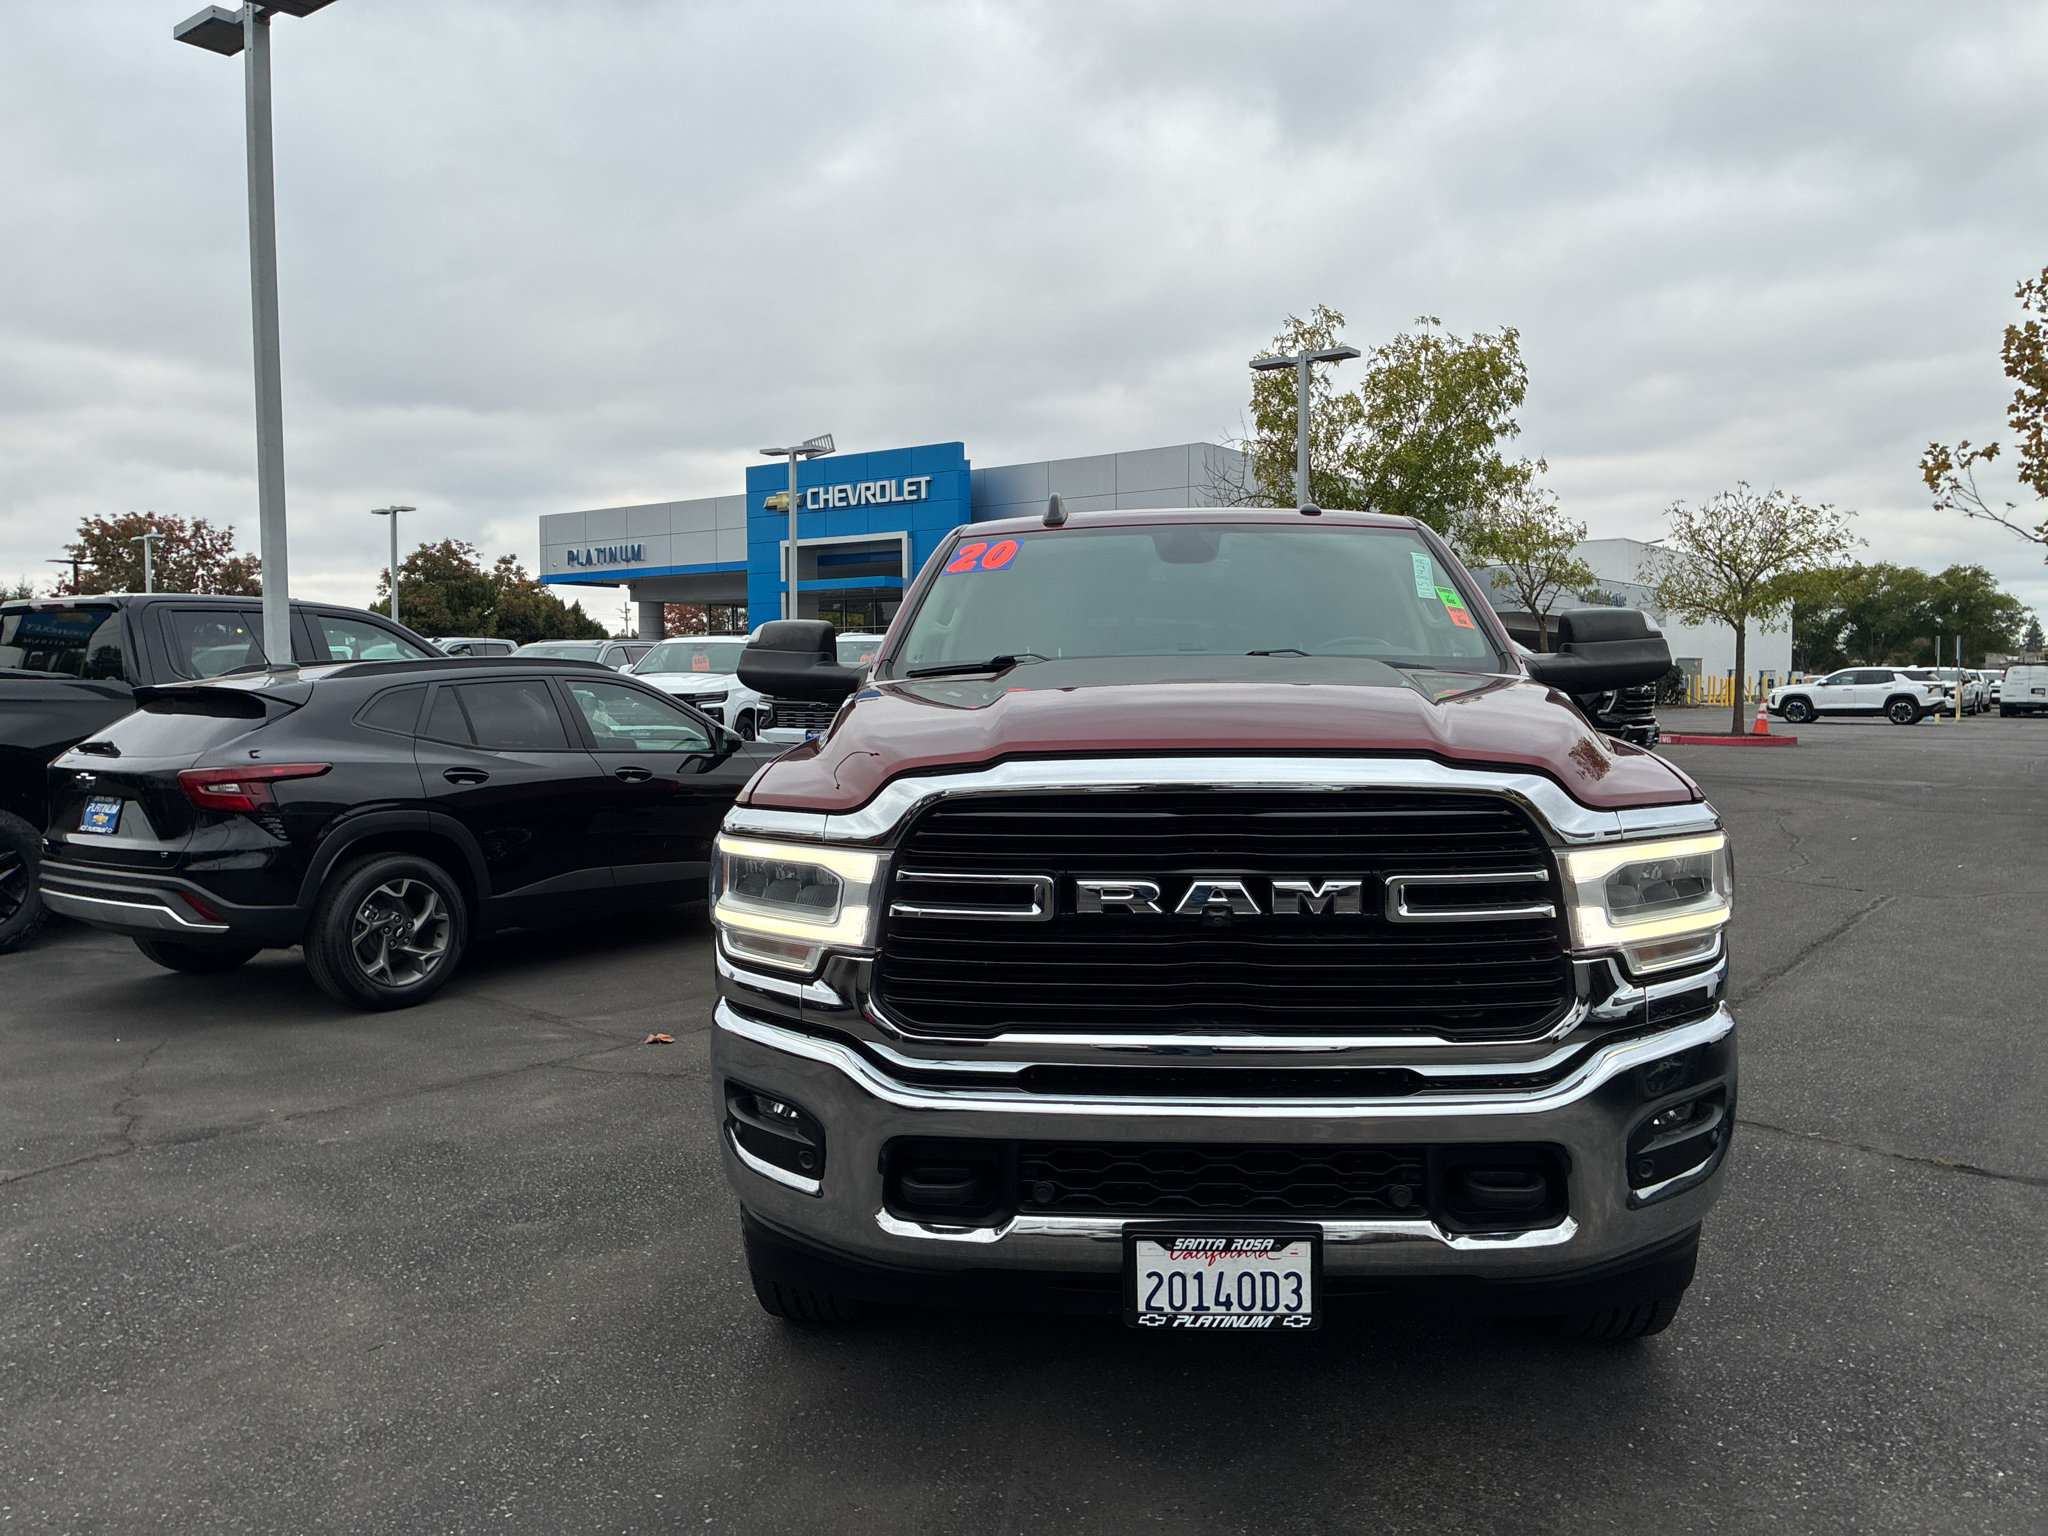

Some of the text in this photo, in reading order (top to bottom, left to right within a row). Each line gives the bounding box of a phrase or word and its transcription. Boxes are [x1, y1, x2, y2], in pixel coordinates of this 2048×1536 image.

[806, 476, 931, 510] CHEVROLET
[566, 543, 644, 567] PLATINUM
[946, 540, 1018, 572] 20
[86, 803, 121, 814] PLATINUM
[1076, 880, 1362, 915] RAM
[1173, 1238, 1275, 1250] SANTA ROSA
[1145, 1271, 1303, 1312] 20140D3
[1172, 1315, 1275, 1328] PLATINUM
